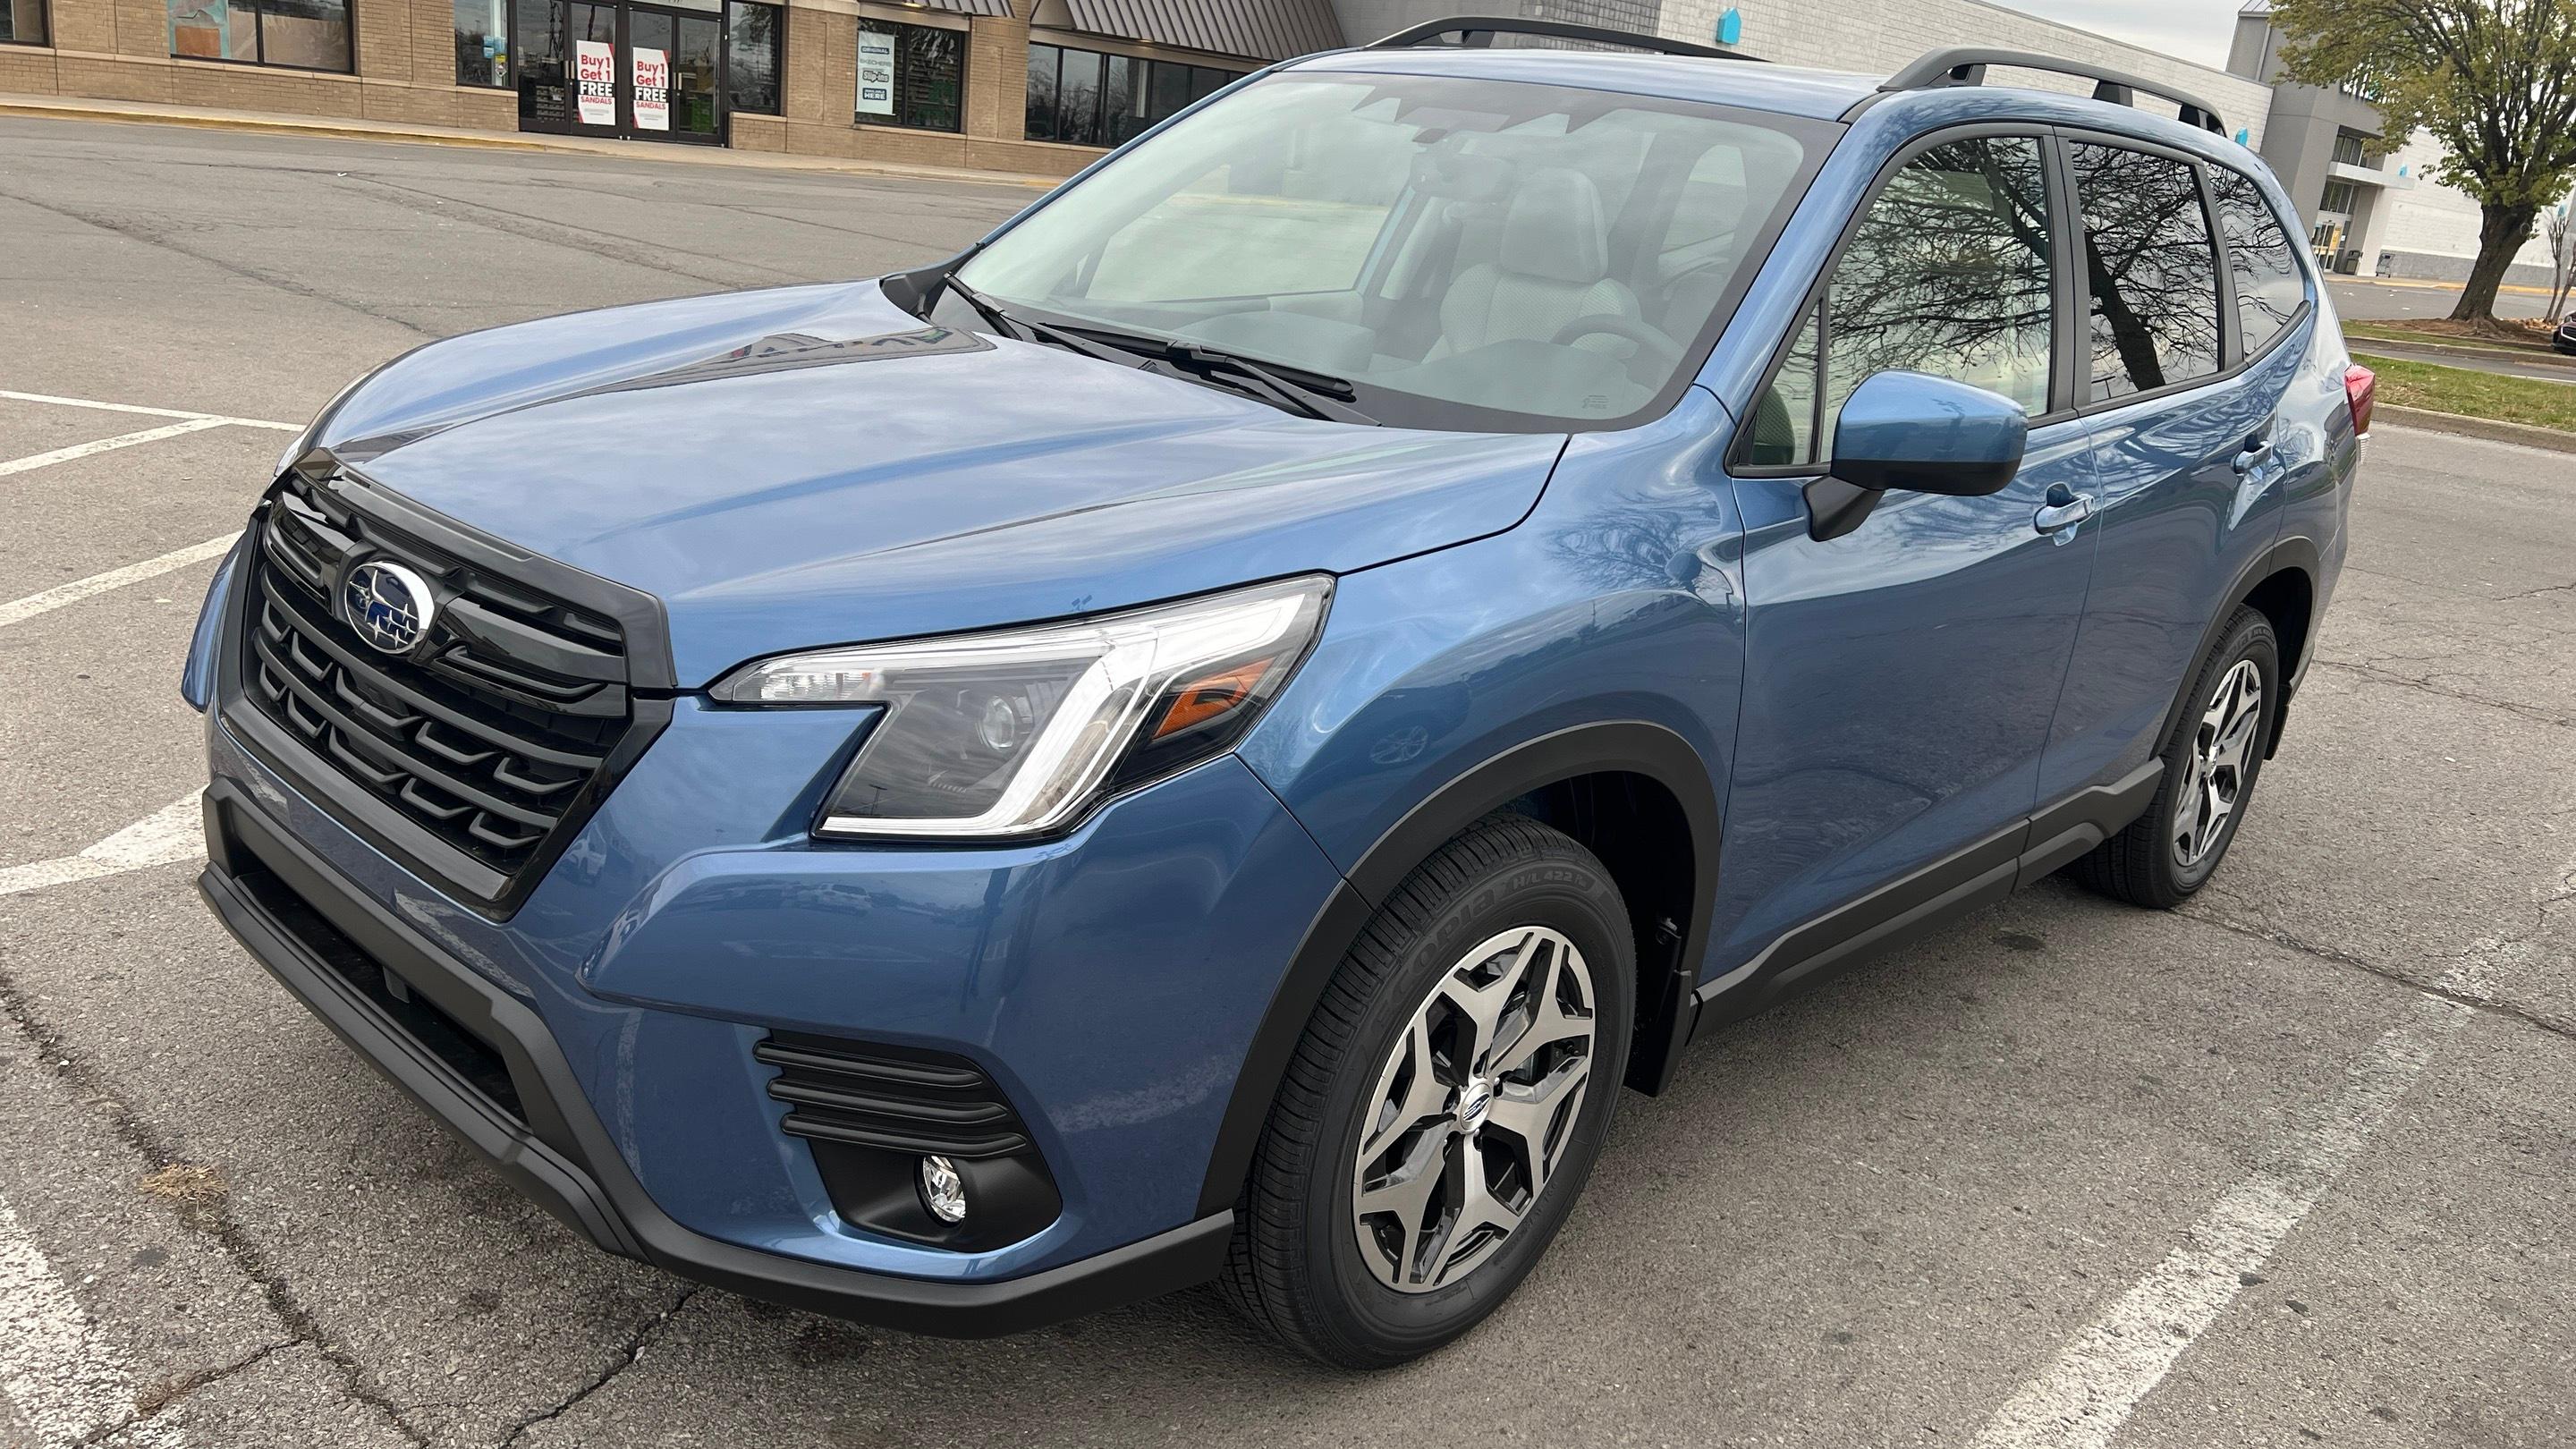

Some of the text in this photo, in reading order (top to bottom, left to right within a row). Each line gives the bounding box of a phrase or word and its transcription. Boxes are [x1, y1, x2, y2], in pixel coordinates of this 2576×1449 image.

[581, 55, 610, 69] Buy 1
[636, 61, 665, 76] Buy 1
[580, 68, 610, 81] Get 1
[636, 74, 665, 87] Get 1
[580, 80, 613, 97] FREE
[635, 87, 667, 102] FREE
[580, 96, 613, 105] SANDALS
[864, 92, 886, 100] HERE
[636, 101, 666, 110] SANDALS
